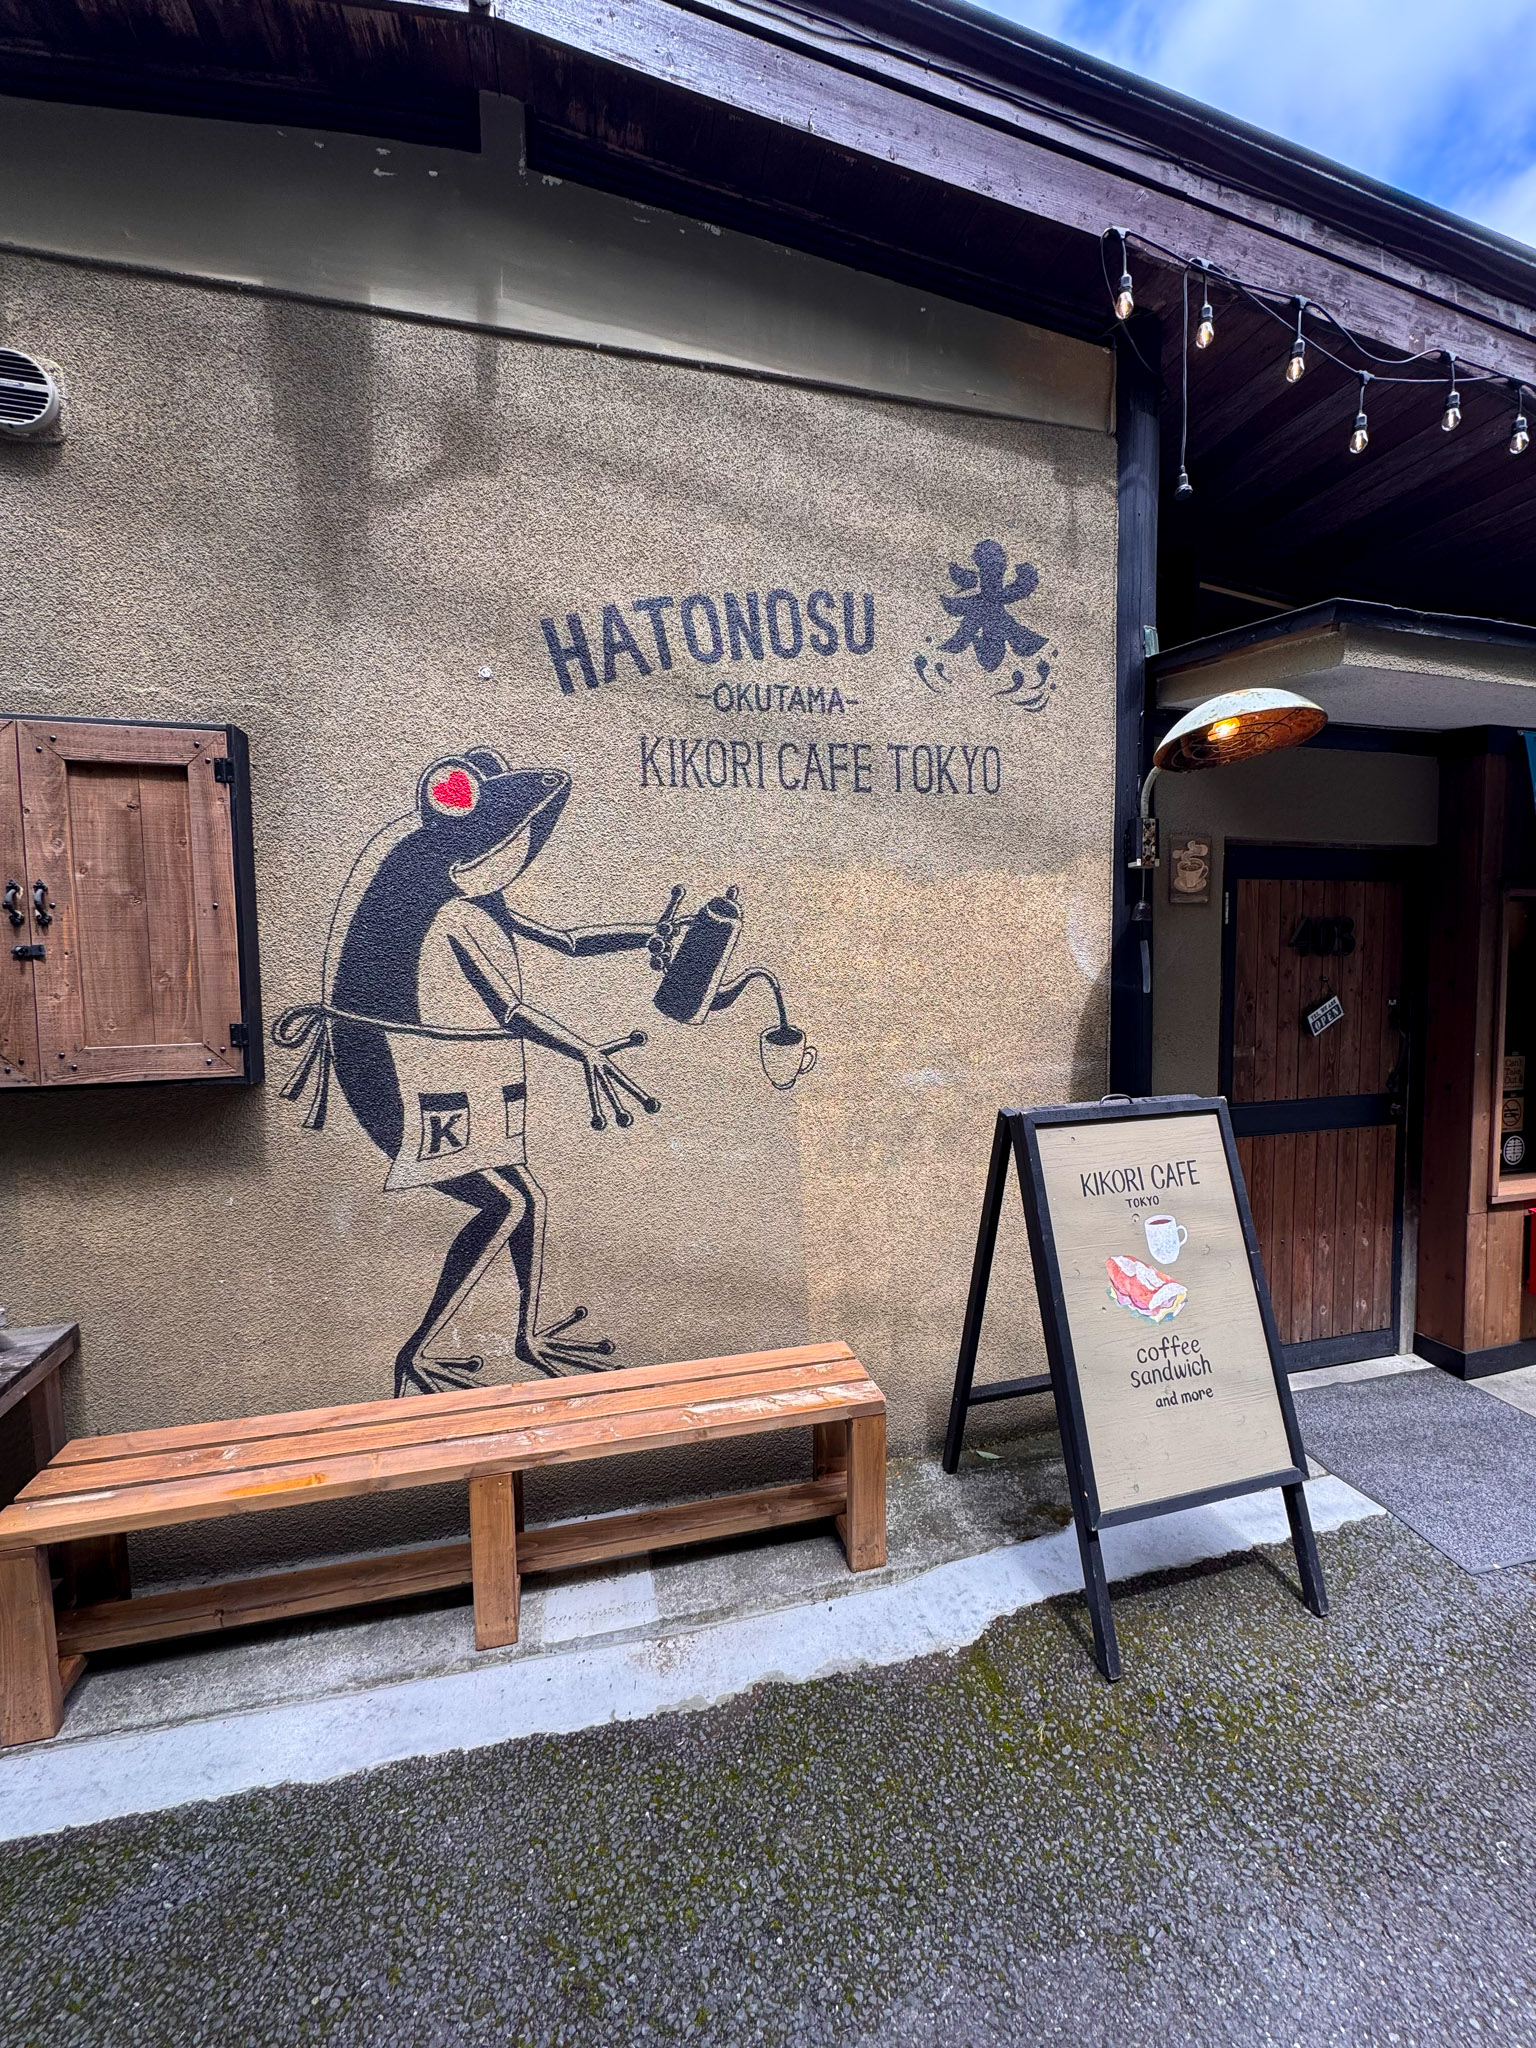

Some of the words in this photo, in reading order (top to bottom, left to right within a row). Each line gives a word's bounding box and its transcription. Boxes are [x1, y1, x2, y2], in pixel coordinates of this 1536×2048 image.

[940, 539, 1050, 671] 氷
[541, 588, 875, 694] HATONOSU
[640, 736, 765, 790] KIKORI
[777, 742, 873, 793] CAFE
[887, 744, 1001, 795] TOKYO
[1314, 1006, 1340, 1031] OPEN
[428, 1113, 463, 1154] K
[1080, 1166, 1145, 1197] KIKORI
[1150, 1160, 1200, 1189] CAFE
[1125, 1195, 1160, 1208] TOKYO
[1136, 1334, 1202, 1364] coffee
[1130, 1353, 1213, 1388] sandwich
[1155, 1390, 1179, 1408] and
[1180, 1387, 1214, 1404] more
